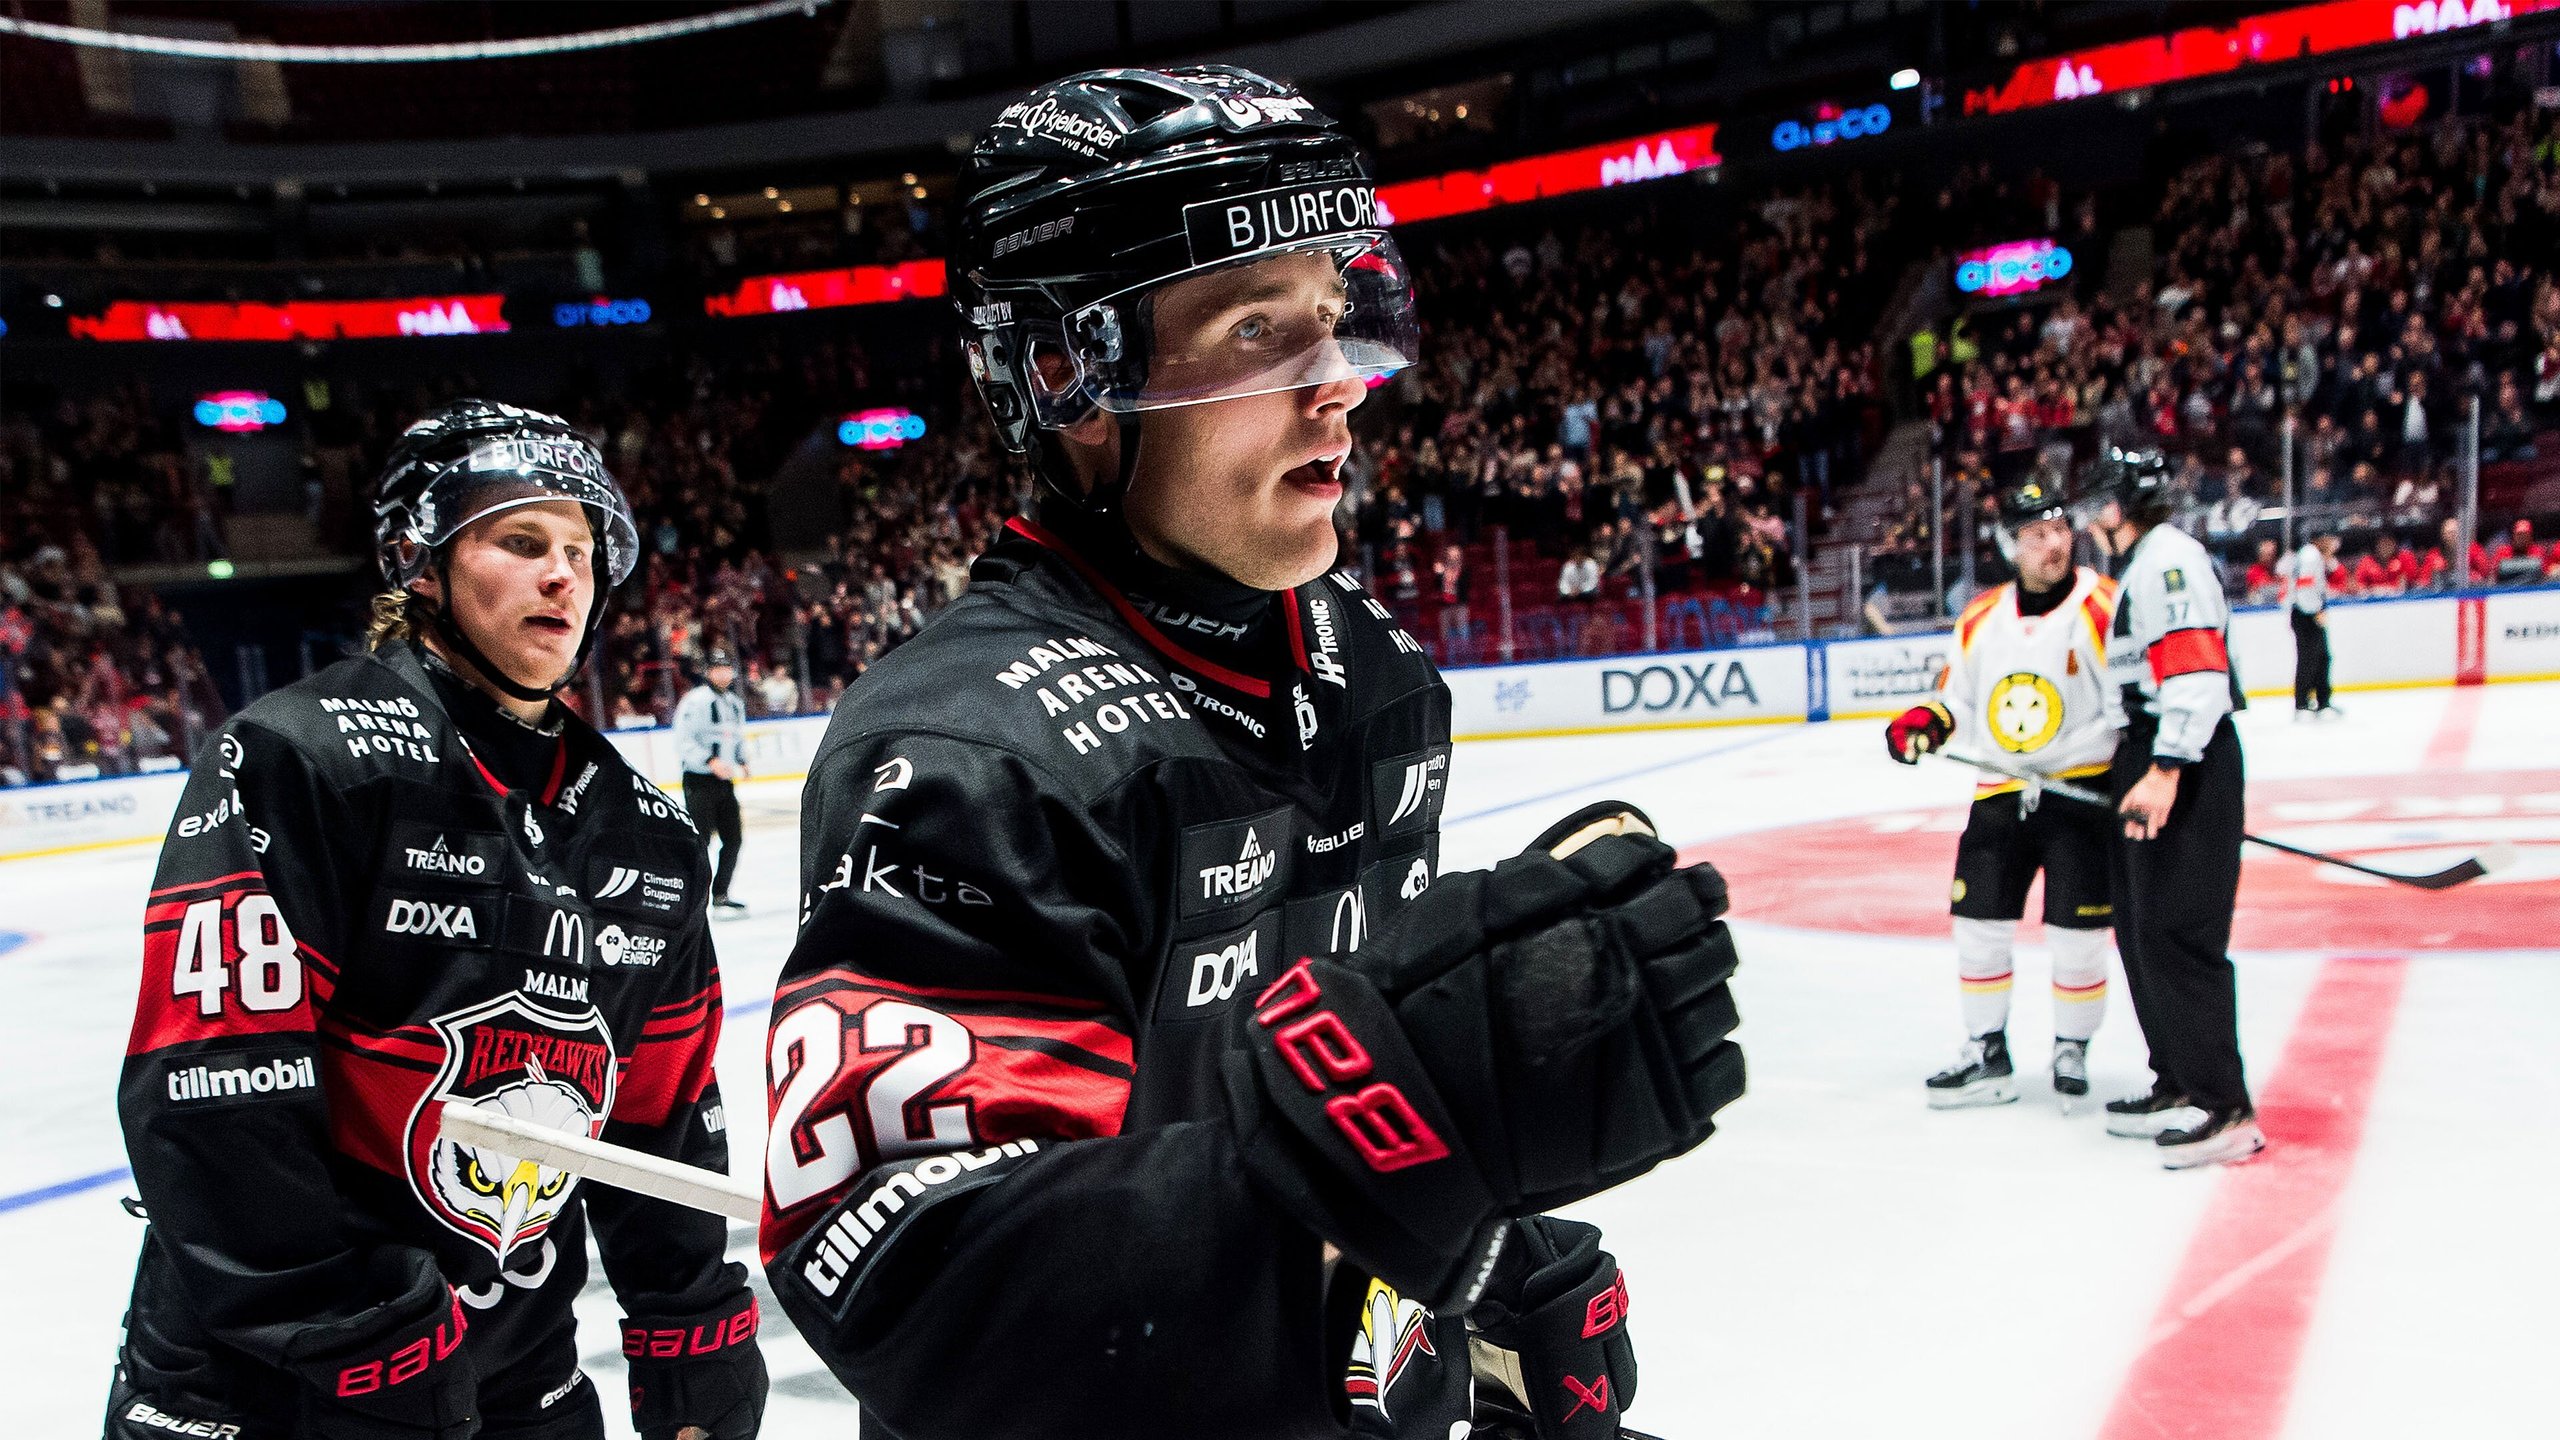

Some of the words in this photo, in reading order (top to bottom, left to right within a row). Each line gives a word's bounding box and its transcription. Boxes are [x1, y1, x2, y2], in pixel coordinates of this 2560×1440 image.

[1043, 107, 1121, 149] kjellander
[999, 301, 1013, 321] BY
[1036, 663, 1160, 718] ARENA
[1602, 660, 1759, 715] DOXA
[319, 696, 419, 718] MALMÖ
[1062, 691, 1191, 756] HOTEL
[337, 713, 432, 739] ARENA
[347, 735, 440, 763] HOTEL
[405, 848, 485, 875] TREANO
[643, 885, 681, 903] Gruppen
[386, 899, 477, 939] DOXA
[174, 894, 302, 1015] 48
[621, 950, 662, 967] ENERGY
[630, 935, 666, 952] CHEAP
[523, 969, 589, 1003] MALM
[168, 1057, 316, 1101] tillmobil
[464, 1024, 607, 1105] REDHAWKS
[765, 1000, 974, 1210] 22
